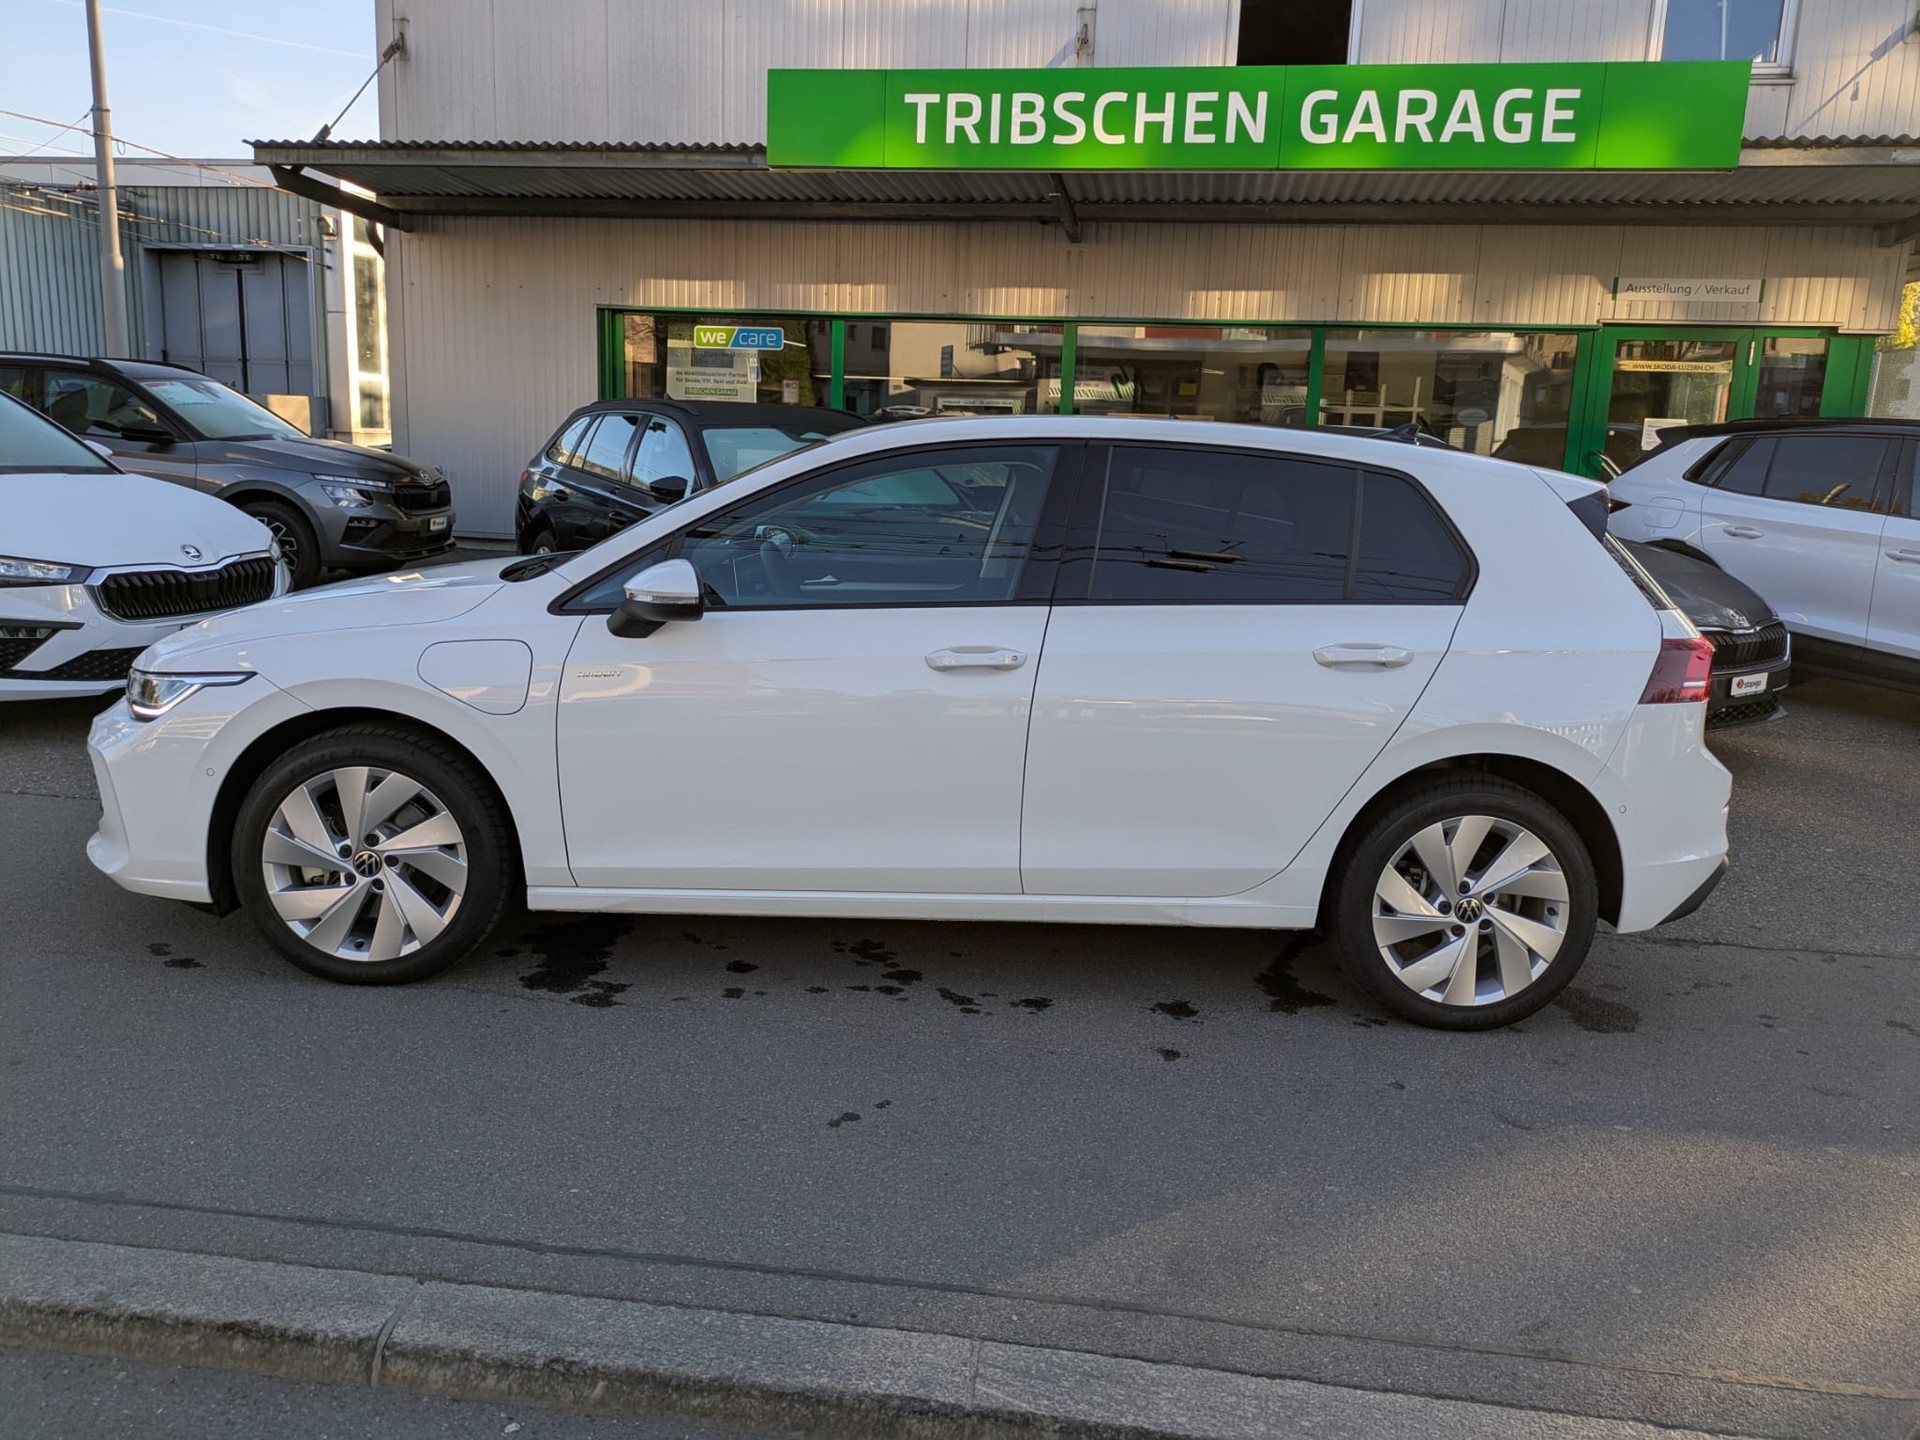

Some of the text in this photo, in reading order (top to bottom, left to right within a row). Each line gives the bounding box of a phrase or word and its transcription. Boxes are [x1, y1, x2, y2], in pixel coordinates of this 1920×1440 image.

[904, 88, 1582, 144] TRIBSCHEN GARAGE
[1625, 283, 1692, 296] Ausstellung
[1704, 284, 1751, 296] Verkauf
[700, 331, 777, 346] we care
